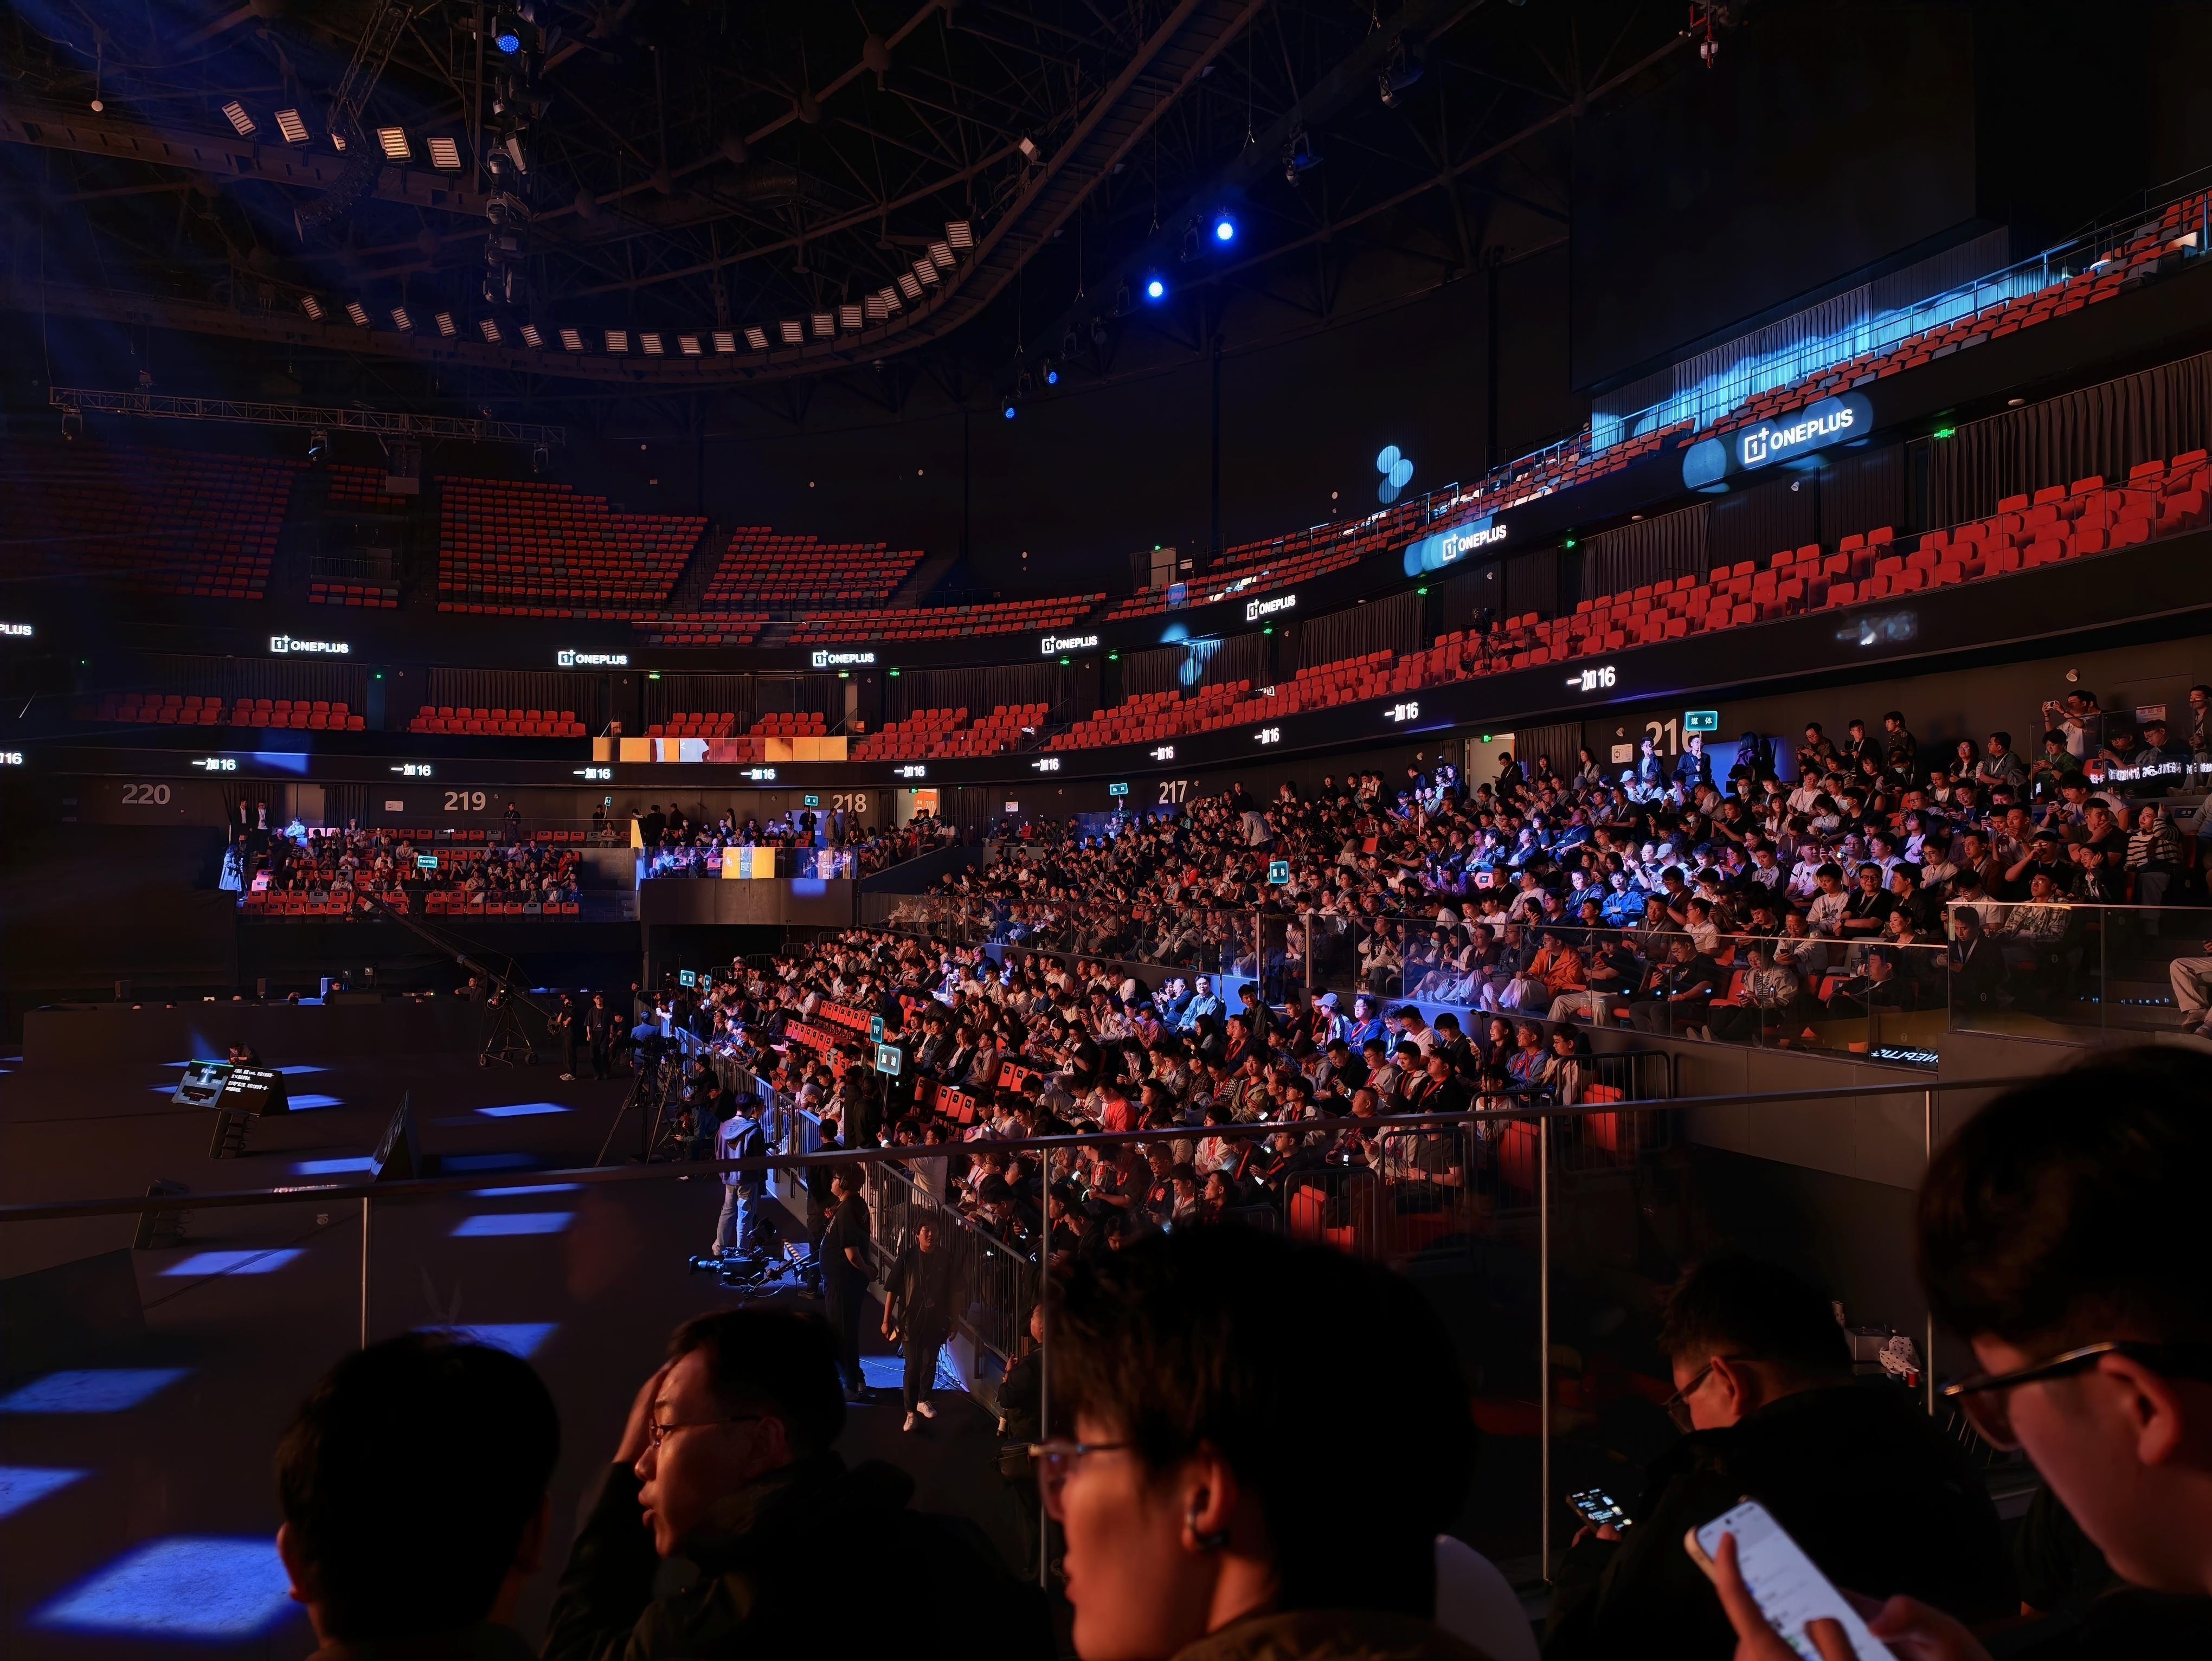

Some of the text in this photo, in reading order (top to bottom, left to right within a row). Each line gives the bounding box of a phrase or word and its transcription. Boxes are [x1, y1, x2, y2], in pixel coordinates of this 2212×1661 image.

[1770, 408, 1854, 450] ONEPLUS
[1457, 524, 1507, 552] ONEPLUS
[1258, 594, 1296, 615] ONEPLUS
[291, 638, 349, 653] ONEPLUS
[1056, 635, 1098, 650] ONEPLUS
[574, 651, 627, 665] ONEPLUS
[826, 652, 874, 664] ONEPLUS
[122, 783, 170, 805] 220
[444, 791, 486, 811] 219
[1159, 780, 1187, 804] 217
[833, 794, 866, 812] 218
